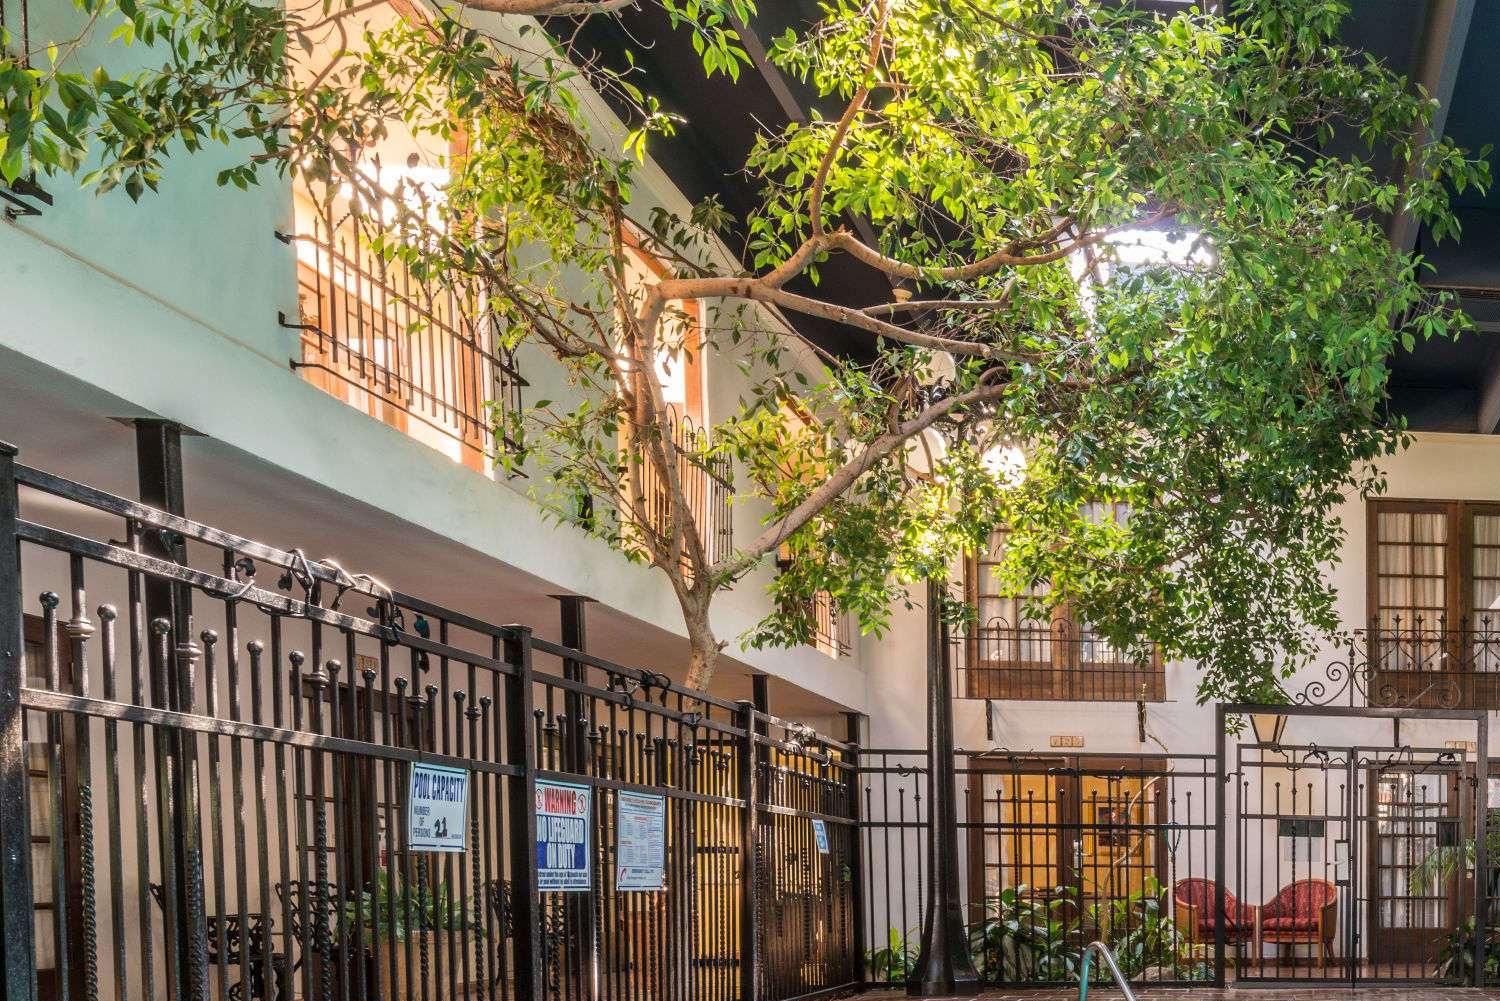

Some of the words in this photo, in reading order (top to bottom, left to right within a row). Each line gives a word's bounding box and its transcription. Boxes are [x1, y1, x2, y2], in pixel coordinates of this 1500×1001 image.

[413, 771, 431, 800] POOL
[432, 773, 465, 803] CAPACITY
[544, 787, 577, 815] WARNING
[536, 815, 548, 843] NO
[548, 816, 585, 844] LIFEGUARD
[546, 842, 557, 869] ON
[557, 843, 576, 869] DUTY
